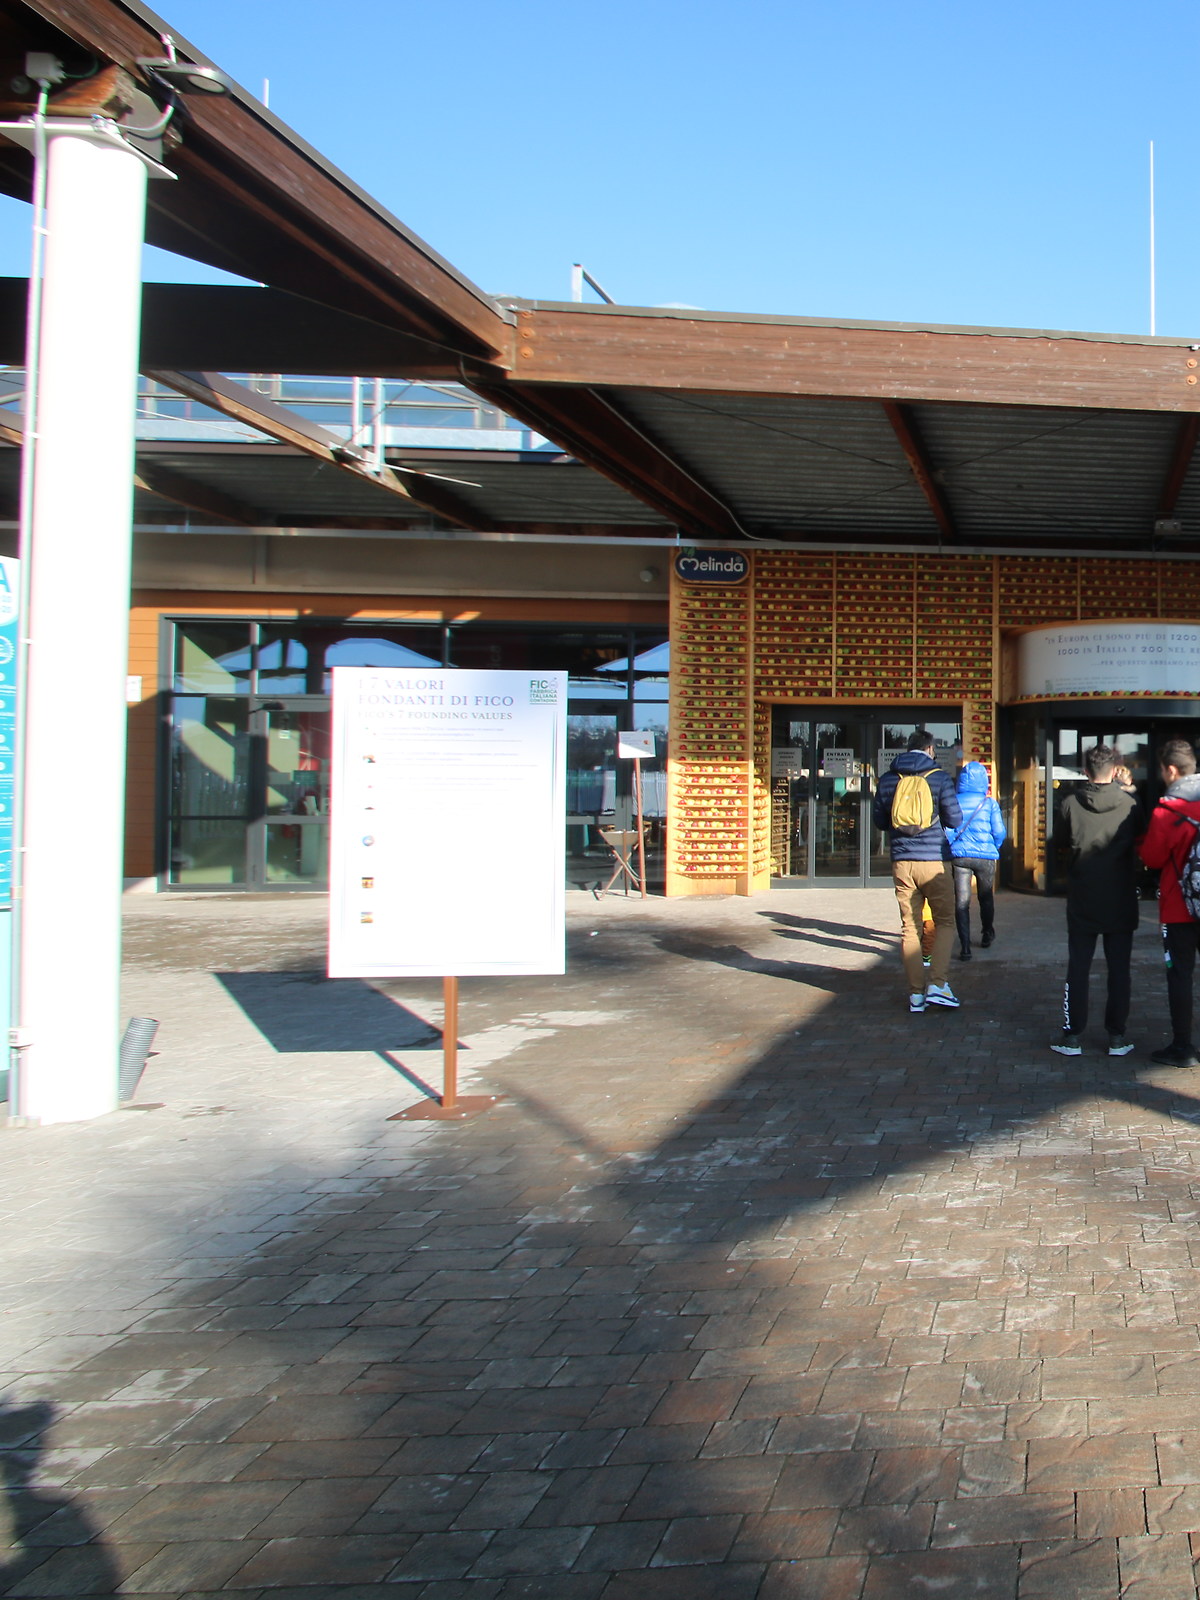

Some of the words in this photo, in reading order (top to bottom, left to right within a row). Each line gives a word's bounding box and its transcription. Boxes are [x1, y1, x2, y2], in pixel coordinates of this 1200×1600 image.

[679, 556, 744, 572] Melinda
[1106, 633, 1132, 641] SONO
[1171, 633, 1198, 641] 1200
[1057, 647, 1080, 656] 1000
[1096, 644, 1127, 653] ITALIA
[1141, 645, 1163, 653] 200
[384, 678, 445, 690] VALORI
[357, 693, 444, 706] FONDANTI
[451, 694, 469, 706] DI
[474, 695, 514, 707] FICO
[408, 711, 468, 720] FOUNDING
[471, 711, 513, 720] VALUES
